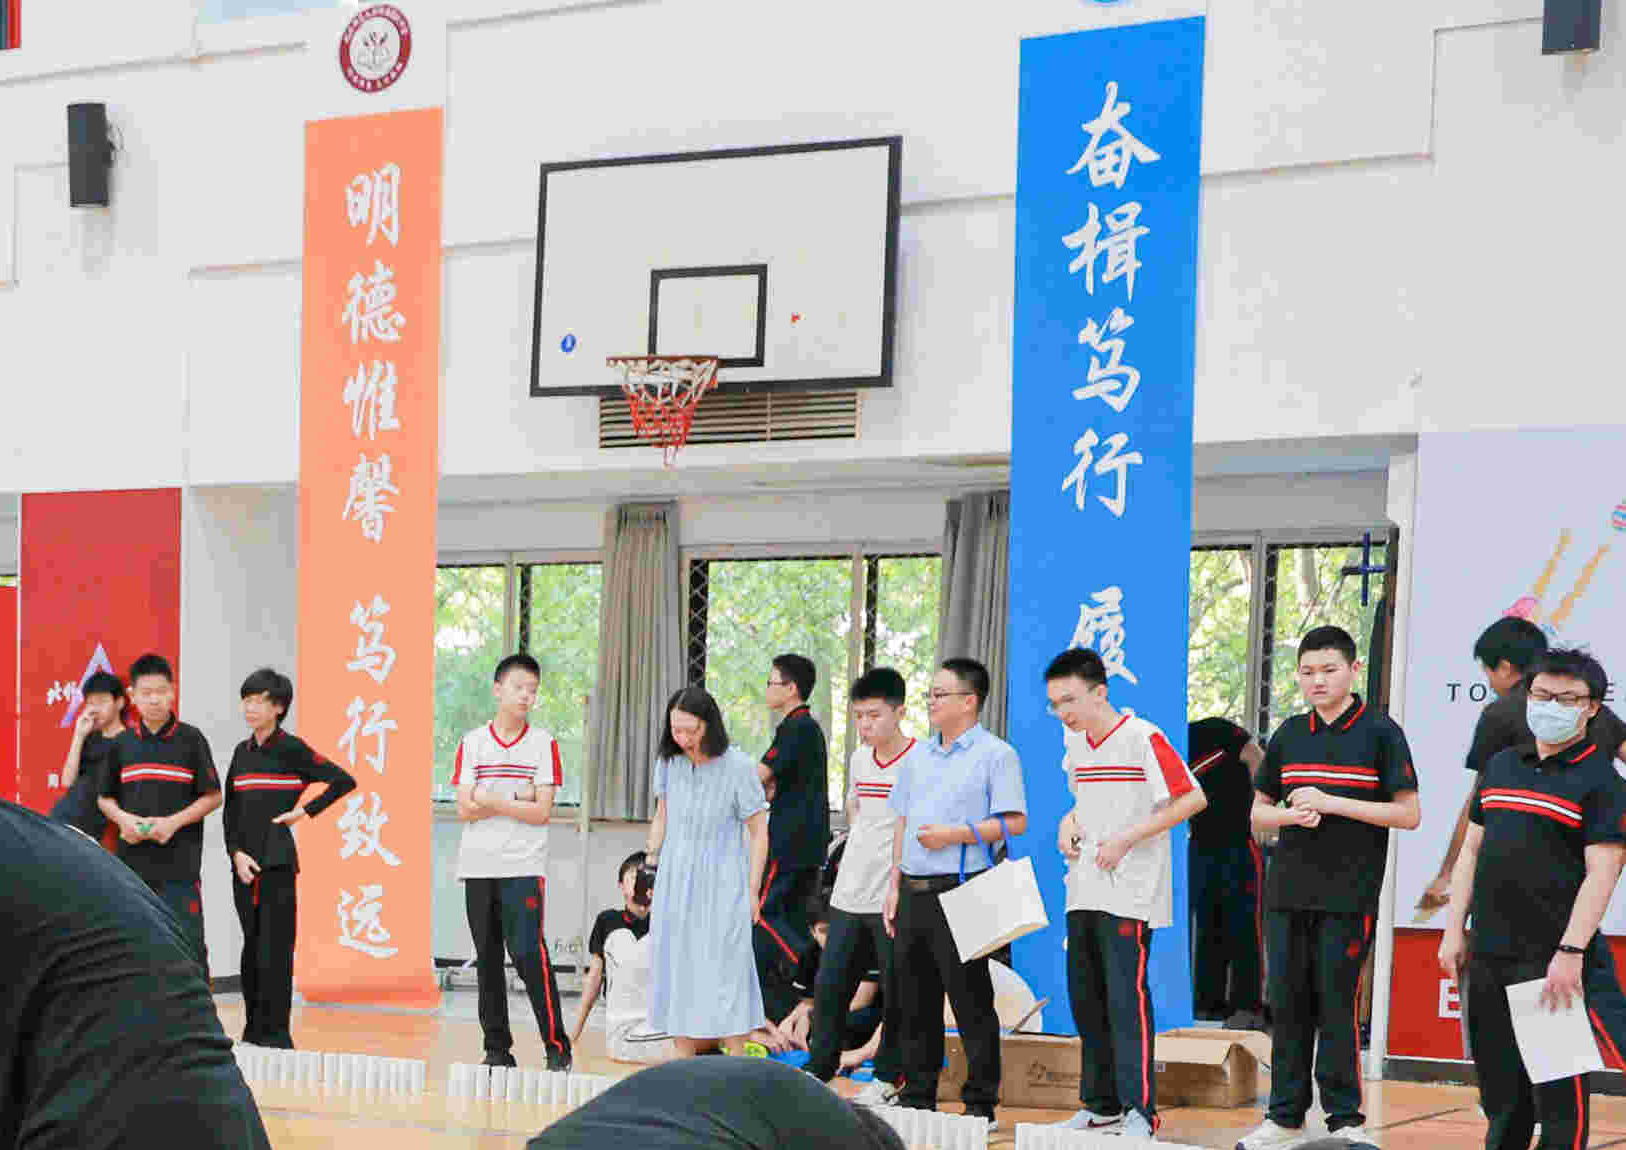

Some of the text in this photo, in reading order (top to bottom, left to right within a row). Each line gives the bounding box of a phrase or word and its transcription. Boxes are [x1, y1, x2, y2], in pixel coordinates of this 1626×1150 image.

[340, 161, 406, 546] 明德惟馨
[1061, 80, 1162, 519] 奋楫笃行
[336, 593, 403, 960] 笃行致远
